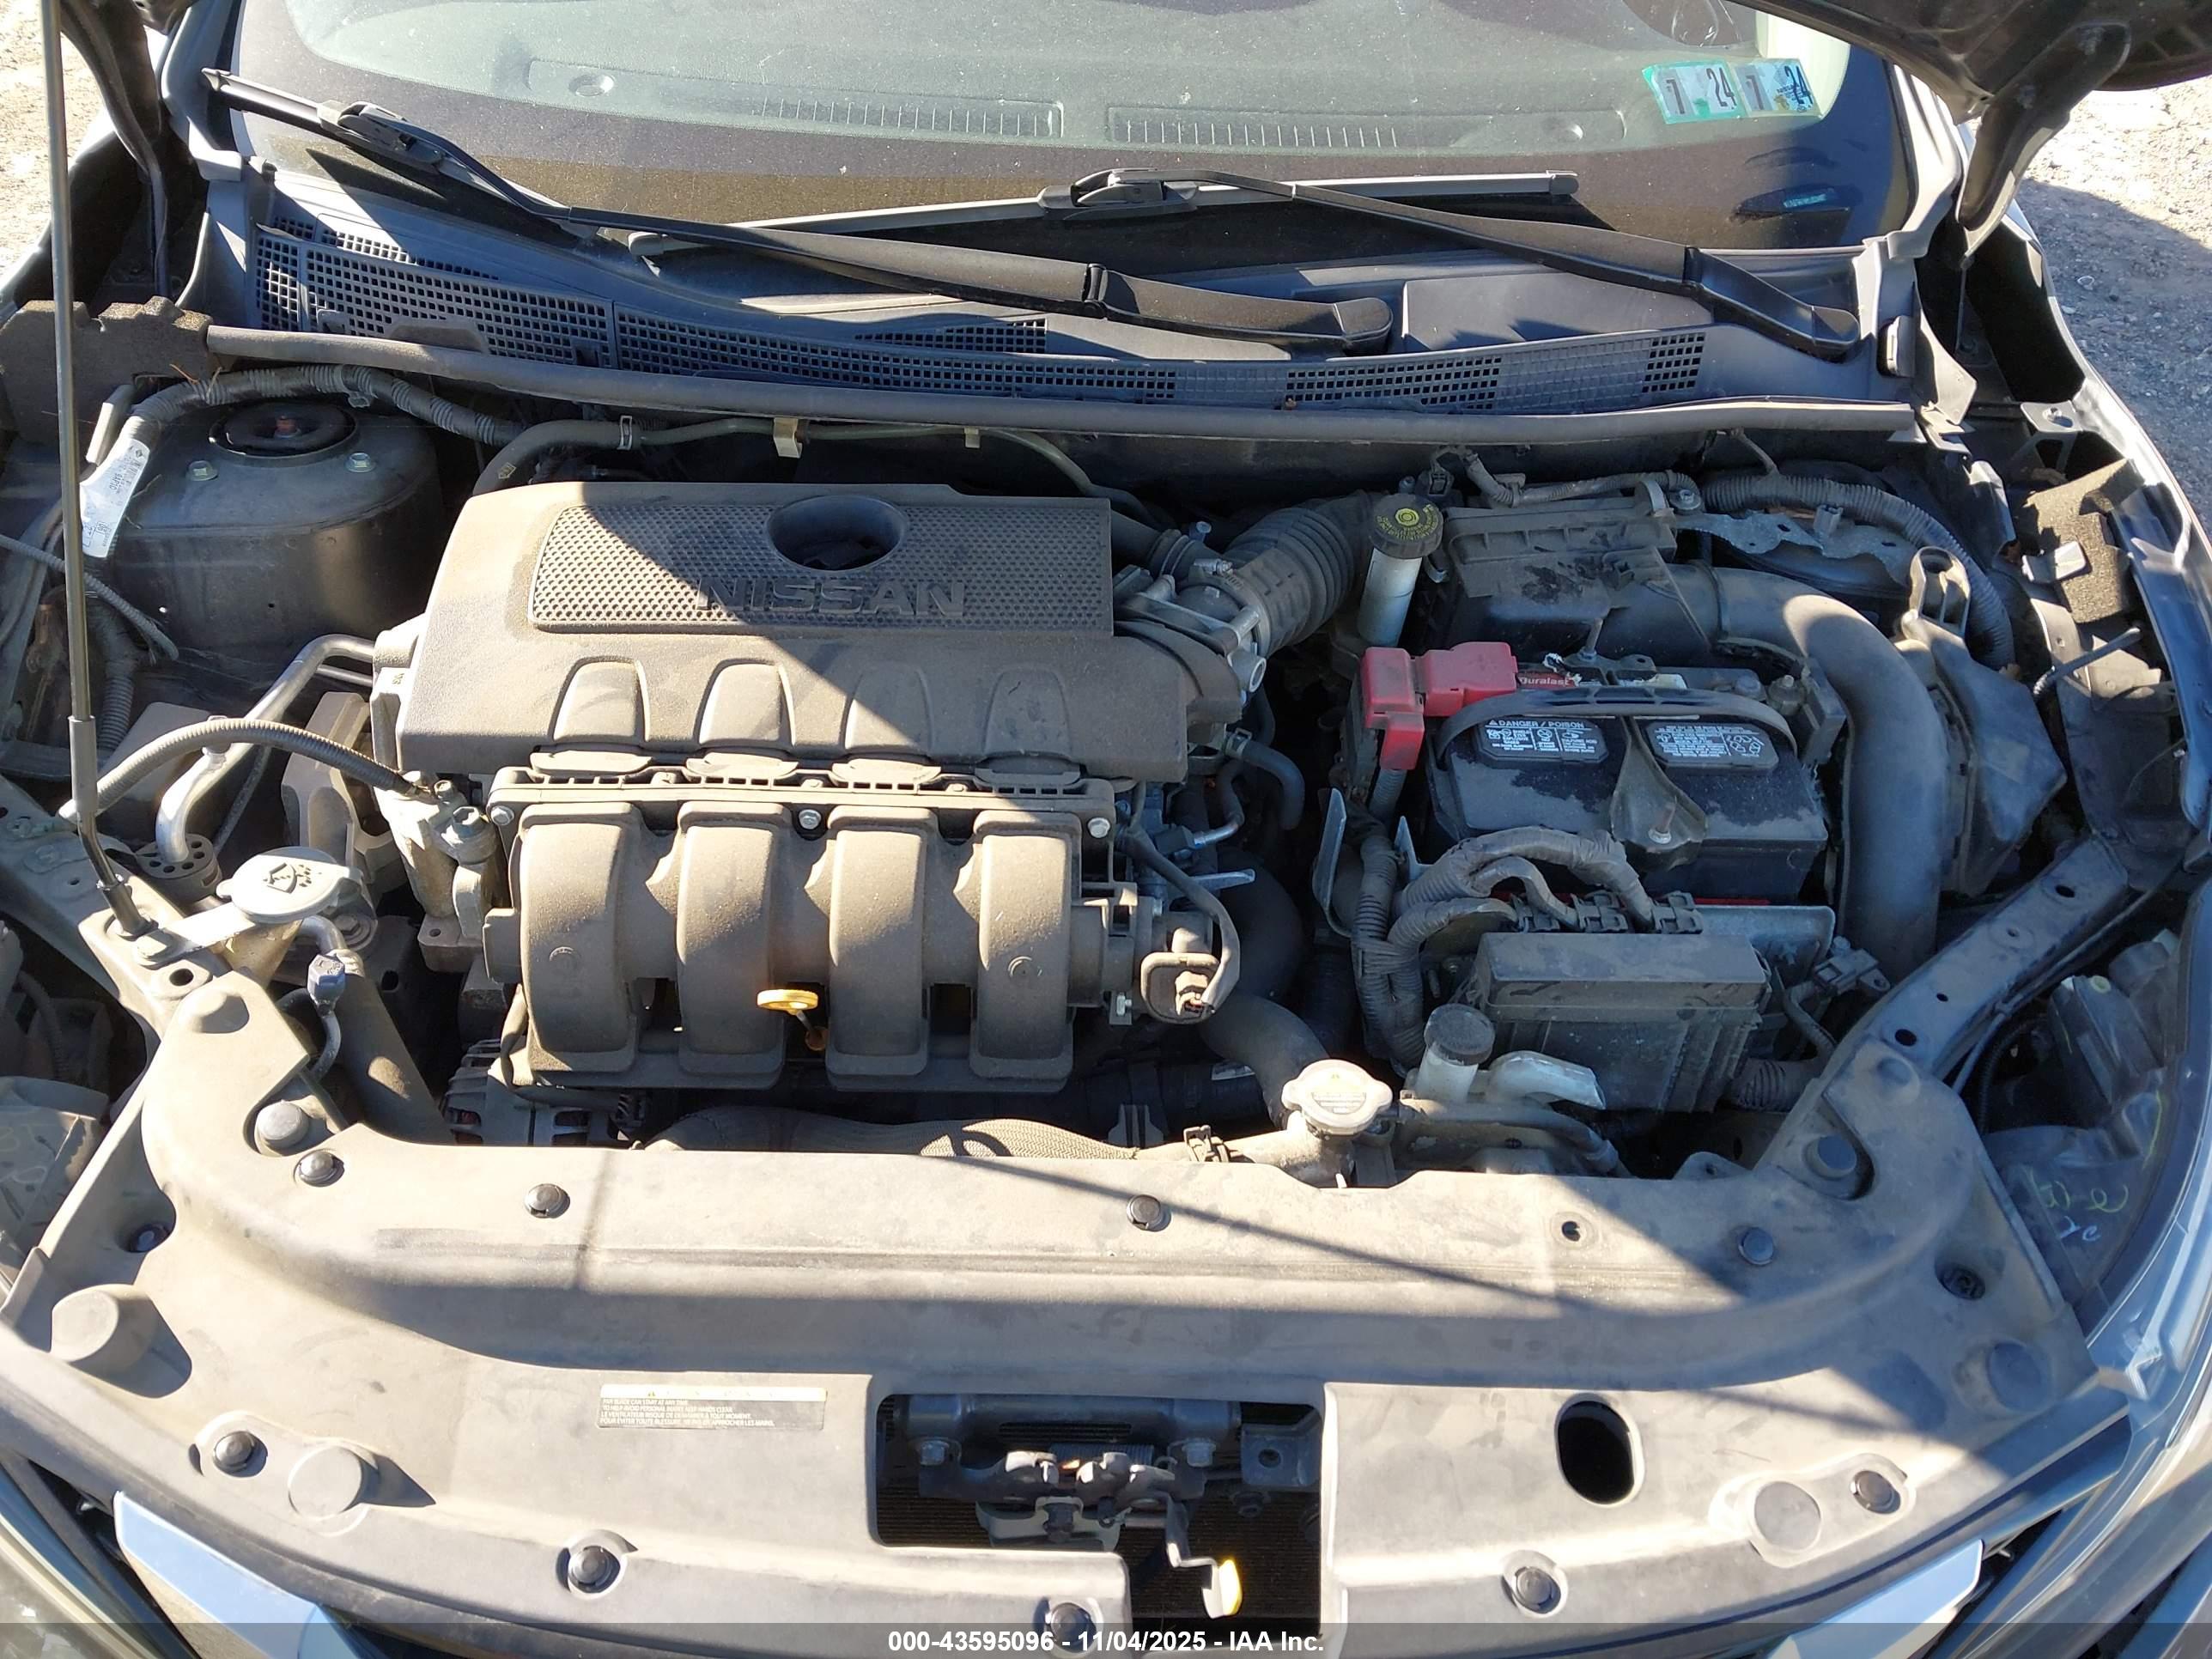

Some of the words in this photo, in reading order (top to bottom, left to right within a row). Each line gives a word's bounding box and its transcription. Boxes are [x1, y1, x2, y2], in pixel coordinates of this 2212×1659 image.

[1706, 68, 1737, 107] 24
[1784, 65, 1814, 106] 24
[696, 578, 964, 617] NISSAN
